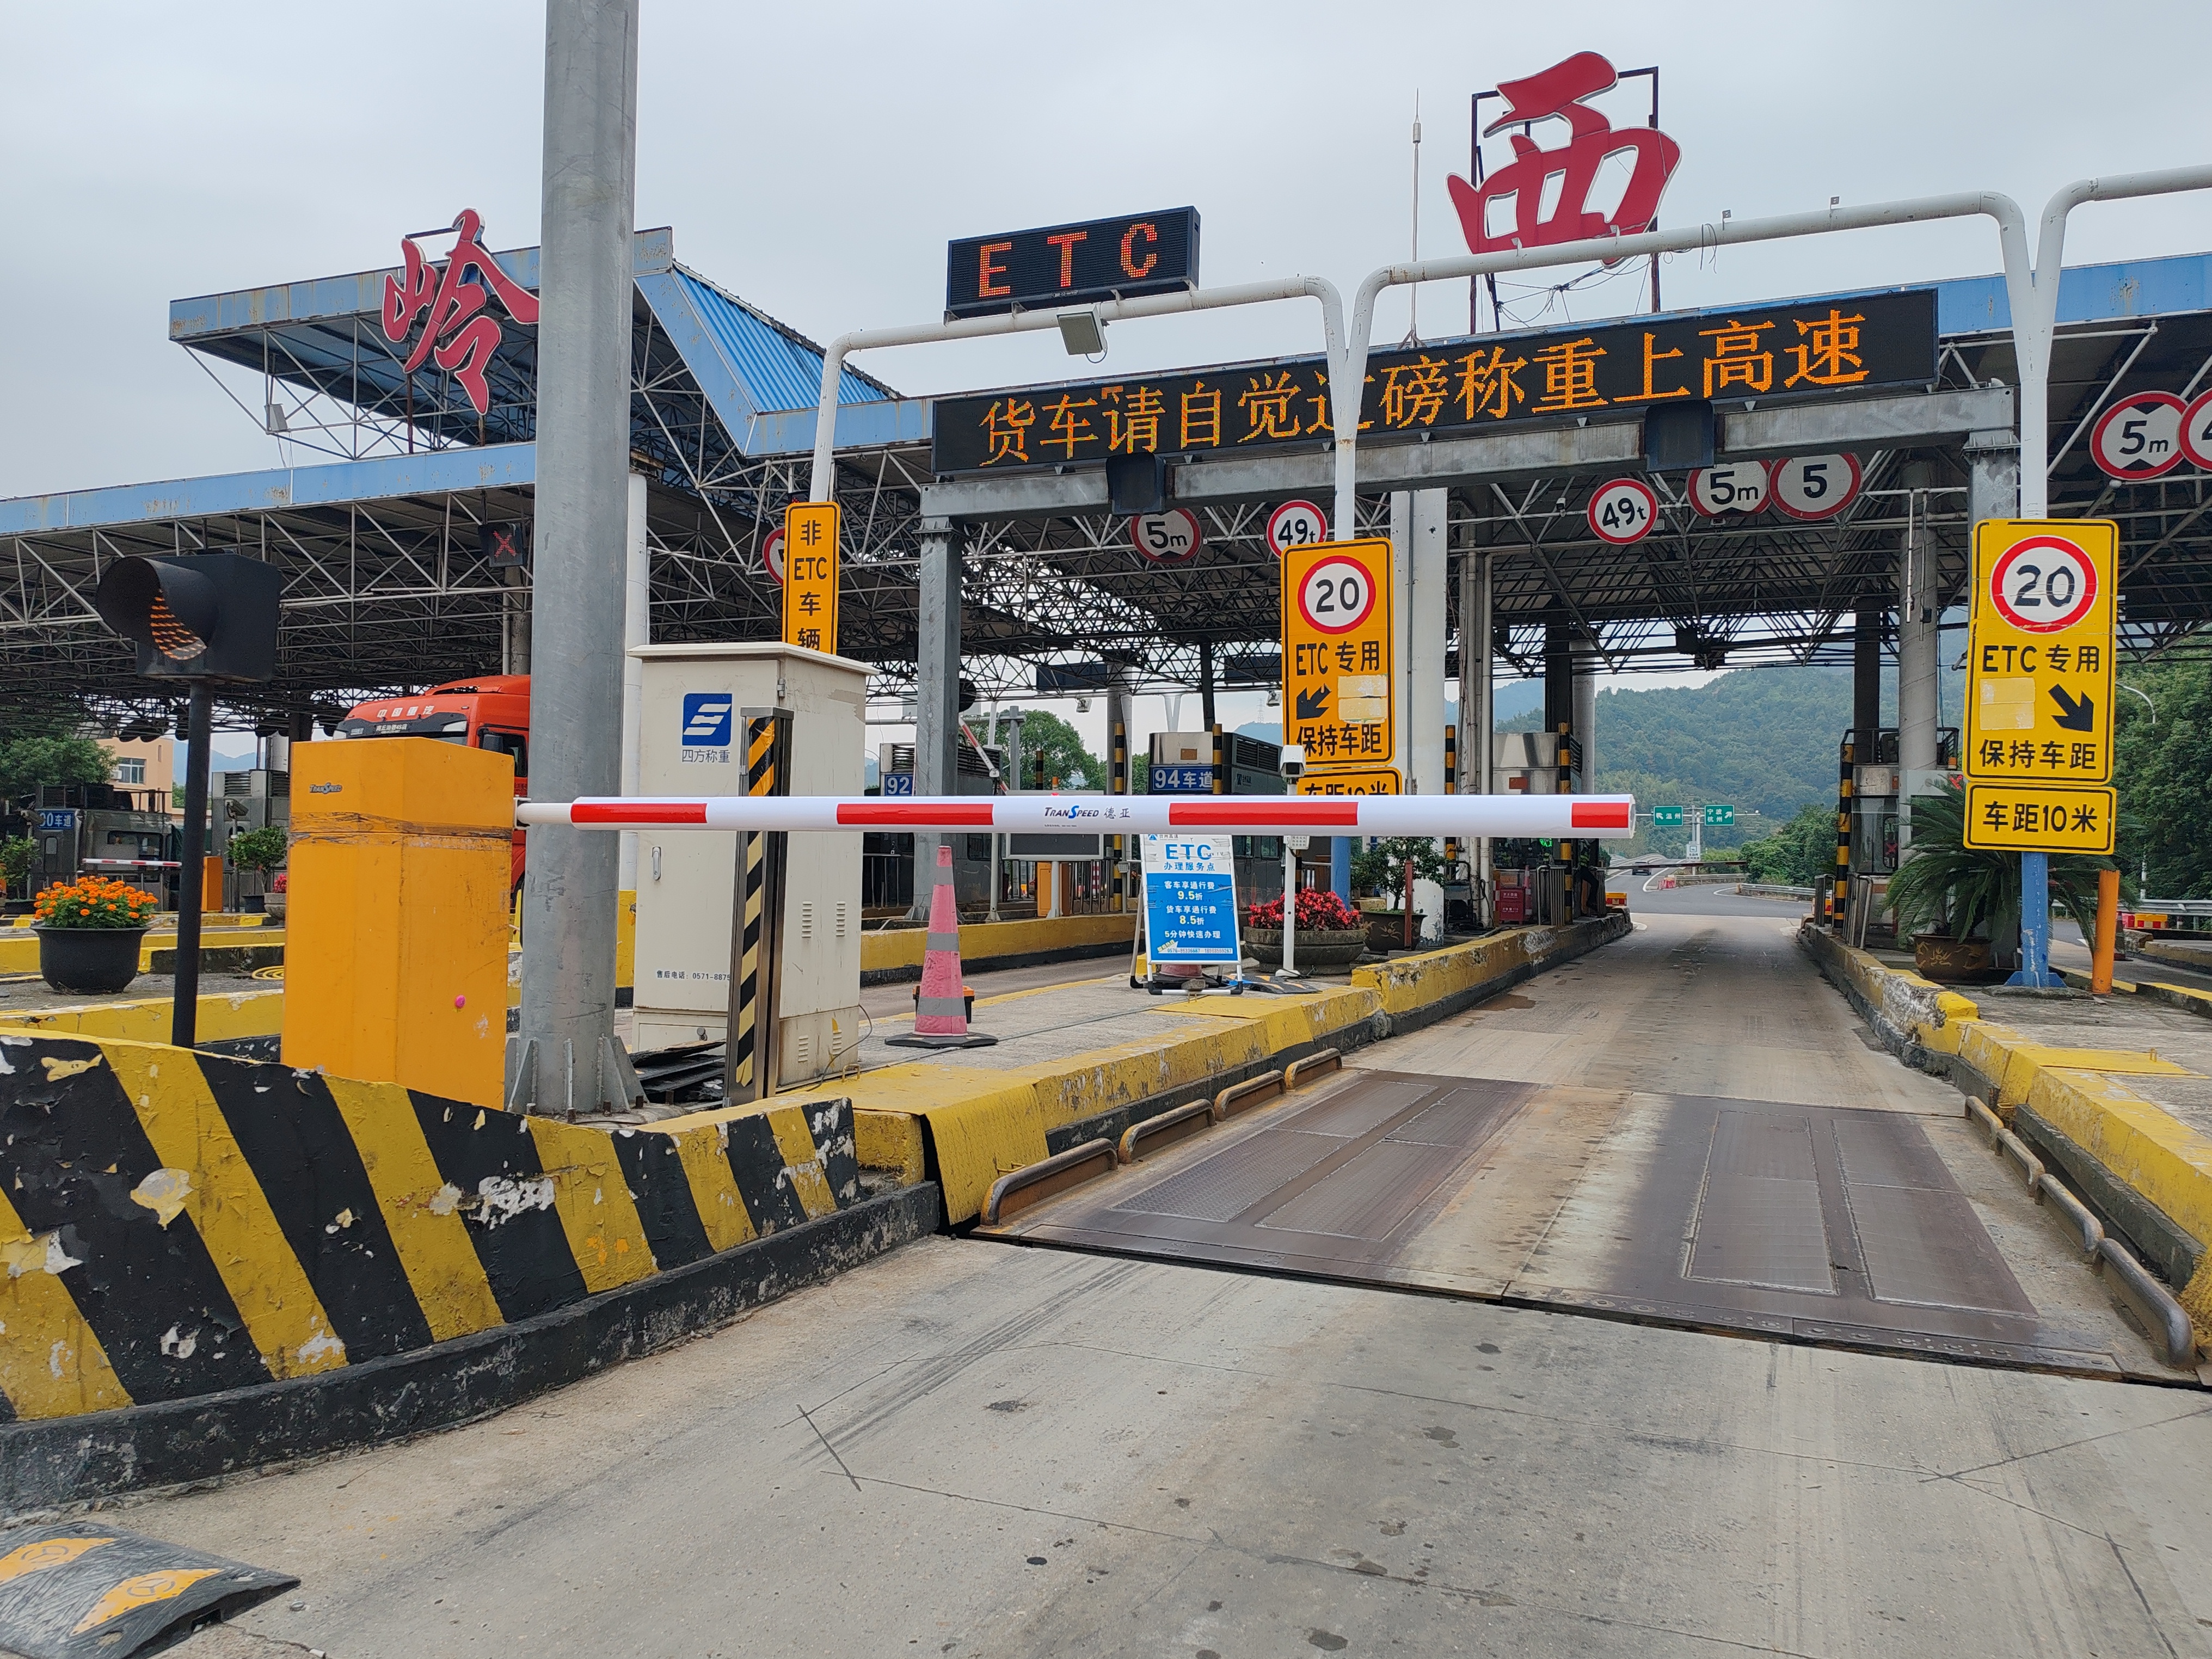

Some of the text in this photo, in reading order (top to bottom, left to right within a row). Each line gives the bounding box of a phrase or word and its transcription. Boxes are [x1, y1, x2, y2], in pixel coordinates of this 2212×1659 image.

[979, 222, 1158, 297] ETC
[2119, 420, 2168, 454] 5m
[1710, 471, 1759, 505] 5m
[1803, 464, 1828, 499] 5
[1602, 497, 1646, 529] 49t
[1146, 520, 1188, 548] 5m
[1277, 519, 1316, 544] 49t
[1316, 577, 1360, 613] 20
[2014, 564, 2075, 608] 20
[1296, 640, 1380, 677] ETC 专用
[1982, 644, 2100, 673] ETC 专用
[1297, 724, 1382, 757] 保持车距
[1979, 739, 2097, 770] 保持车距
[682, 749, 730, 763] 四方称重
[887, 777, 910, 794] 92
[1155, 770, 1213, 788] 94车道
[1104, 806, 1130, 819] 德亚
[1982, 801, 2097, 833] 车距10米
[1165, 844, 1212, 860] ETC
[1164, 862, 1215, 871] 办理服务点
[1164, 881, 1214, 889] 客车享通行费
[1177, 891, 1203, 901] 9.5折
[1166, 905, 1216, 914] 货车享通行费
[1179, 915, 1205, 925] 8.5折
[1165, 930, 1221, 939] 5分钟快速办理
